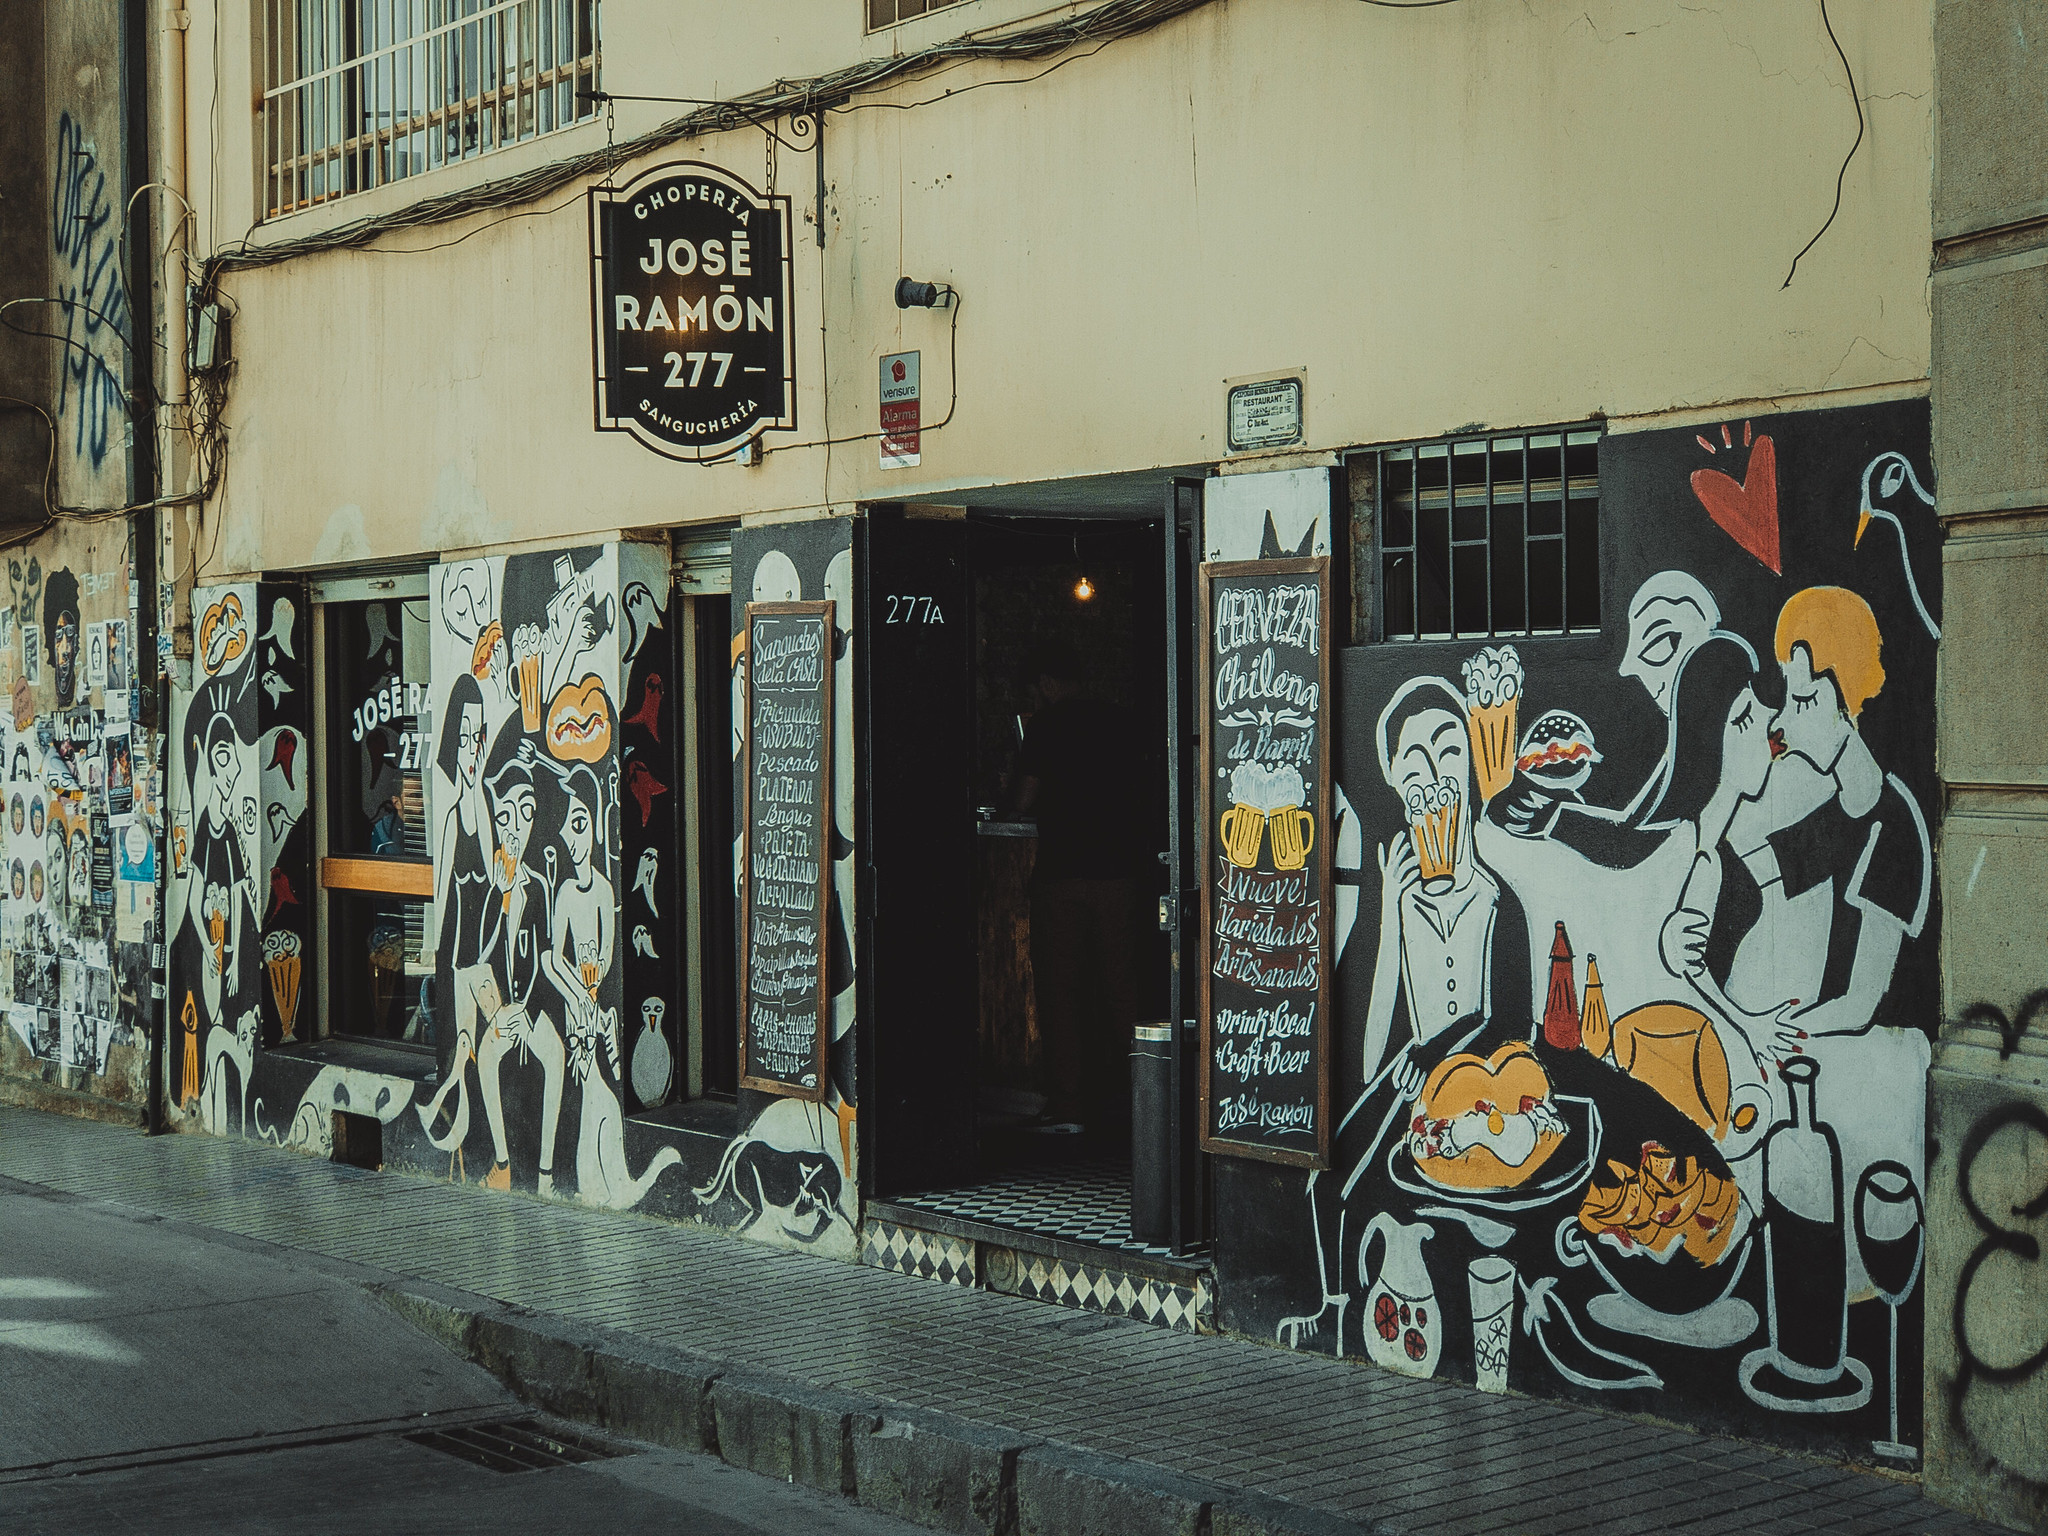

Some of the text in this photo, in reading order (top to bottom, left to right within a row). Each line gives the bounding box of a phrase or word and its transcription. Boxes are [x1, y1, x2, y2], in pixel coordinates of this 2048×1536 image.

[634, 184, 750, 226] CHOPERÍA
[663, 351, 734, 388] 277
[639, 398, 758, 434] SANGUCHERÍA
[1243, 394, 1283, 407] RESTAURANT
[886, 594, 944, 624] 277A
[1215, 583, 1319, 656] CERVEZA
[1216, 647, 1319, 712] Chilena
[762, 723, 817, 749] OSOBUCO
[1227, 729, 1250, 760] de
[757, 750, 819, 775] Pescado
[758, 776, 814, 805] PLATEADA
[758, 803, 812, 832] Lengua
[765, 830, 809, 857] PRIETA
[757, 879, 815, 911] Arrollado
[1231, 872, 1302, 904] Nueve
[1219, 904, 1318, 947] Variedades
[1220, 1000, 1316, 1042] Drink Local
[1220, 1039, 1310, 1083] Craft Beer
